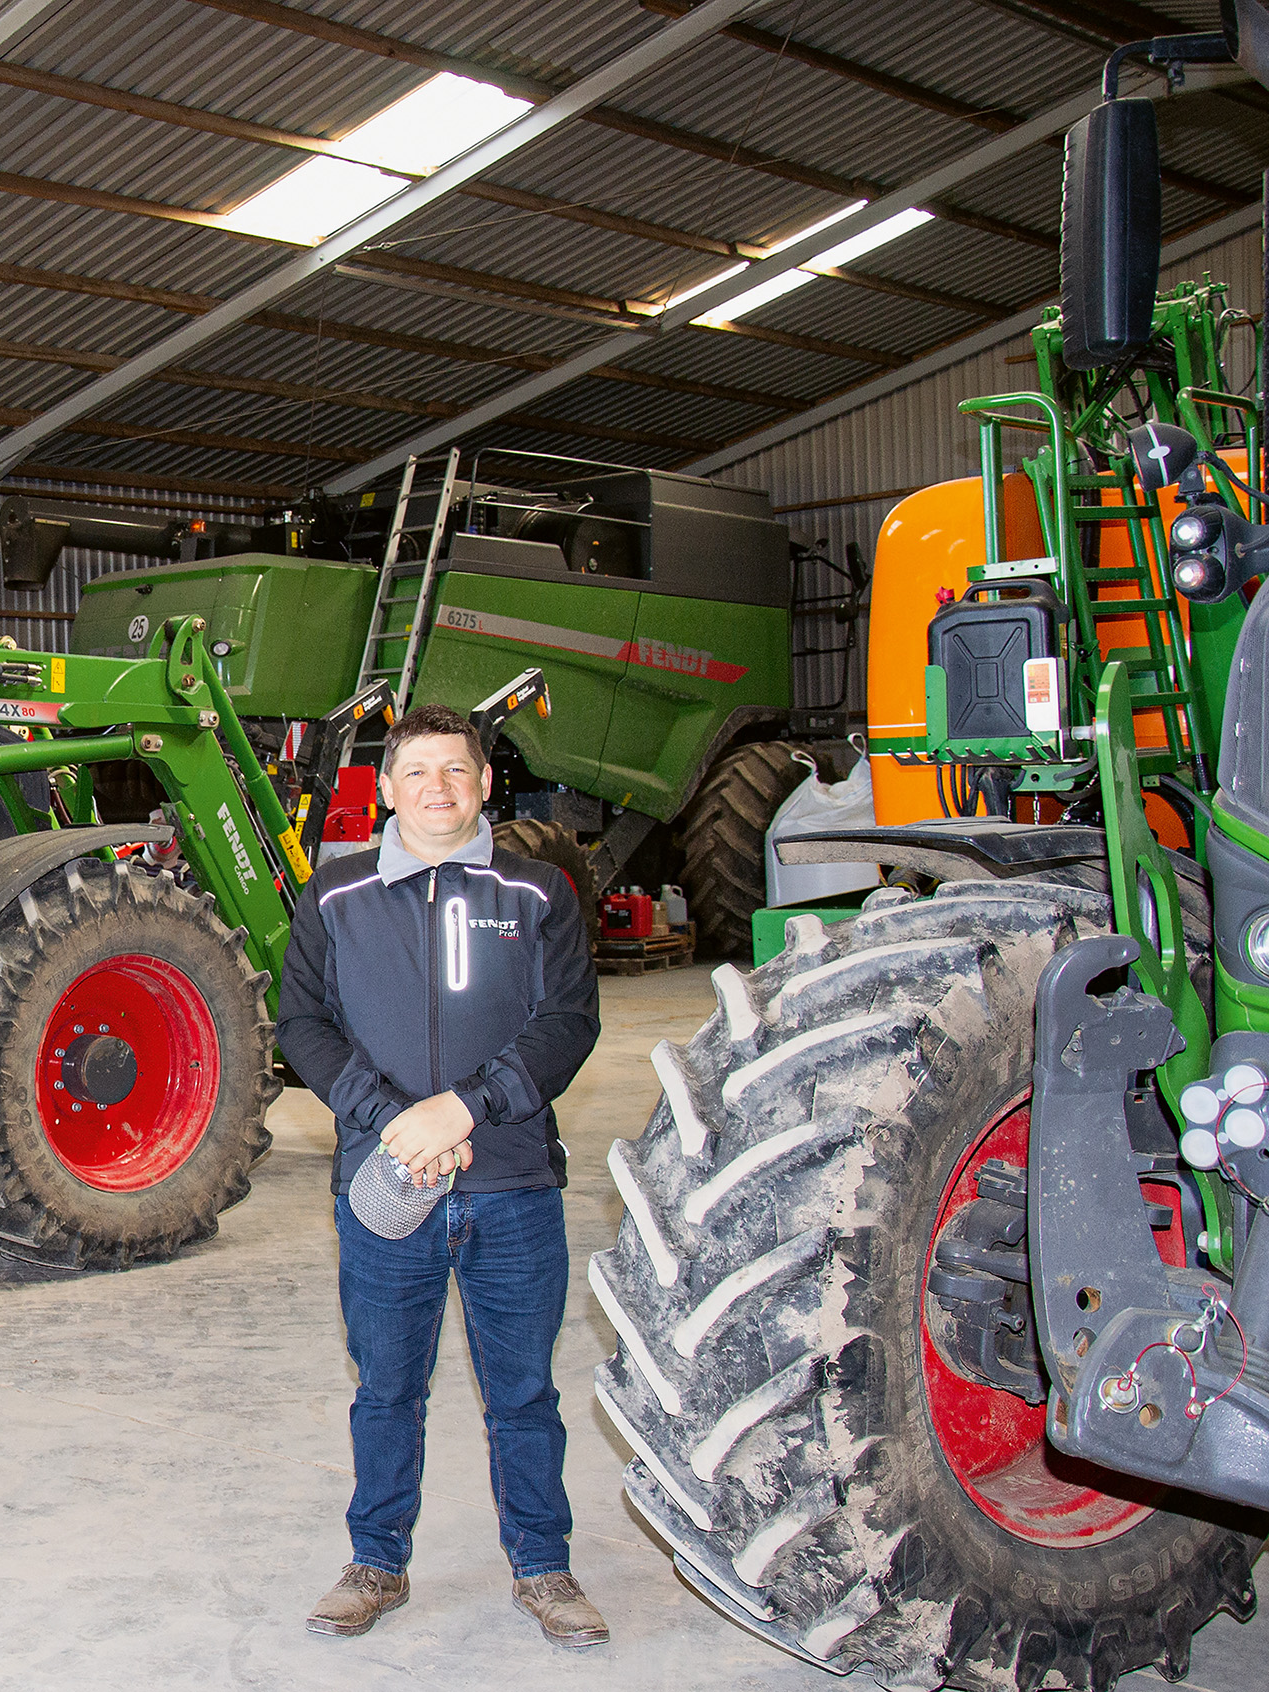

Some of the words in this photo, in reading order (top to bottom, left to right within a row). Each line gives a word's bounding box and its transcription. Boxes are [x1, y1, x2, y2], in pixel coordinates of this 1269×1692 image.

[131, 619, 145, 639] 25
[448, 611, 477, 629] 6275
[637, 637, 713, 675] FENDT
[217, 802, 258, 880] FENDT
[234, 865, 250, 895] CARGO
[468, 919, 518, 930] FENDT
[499, 929, 520, 938] Profi
[1071, 1580, 1101, 1610] R
